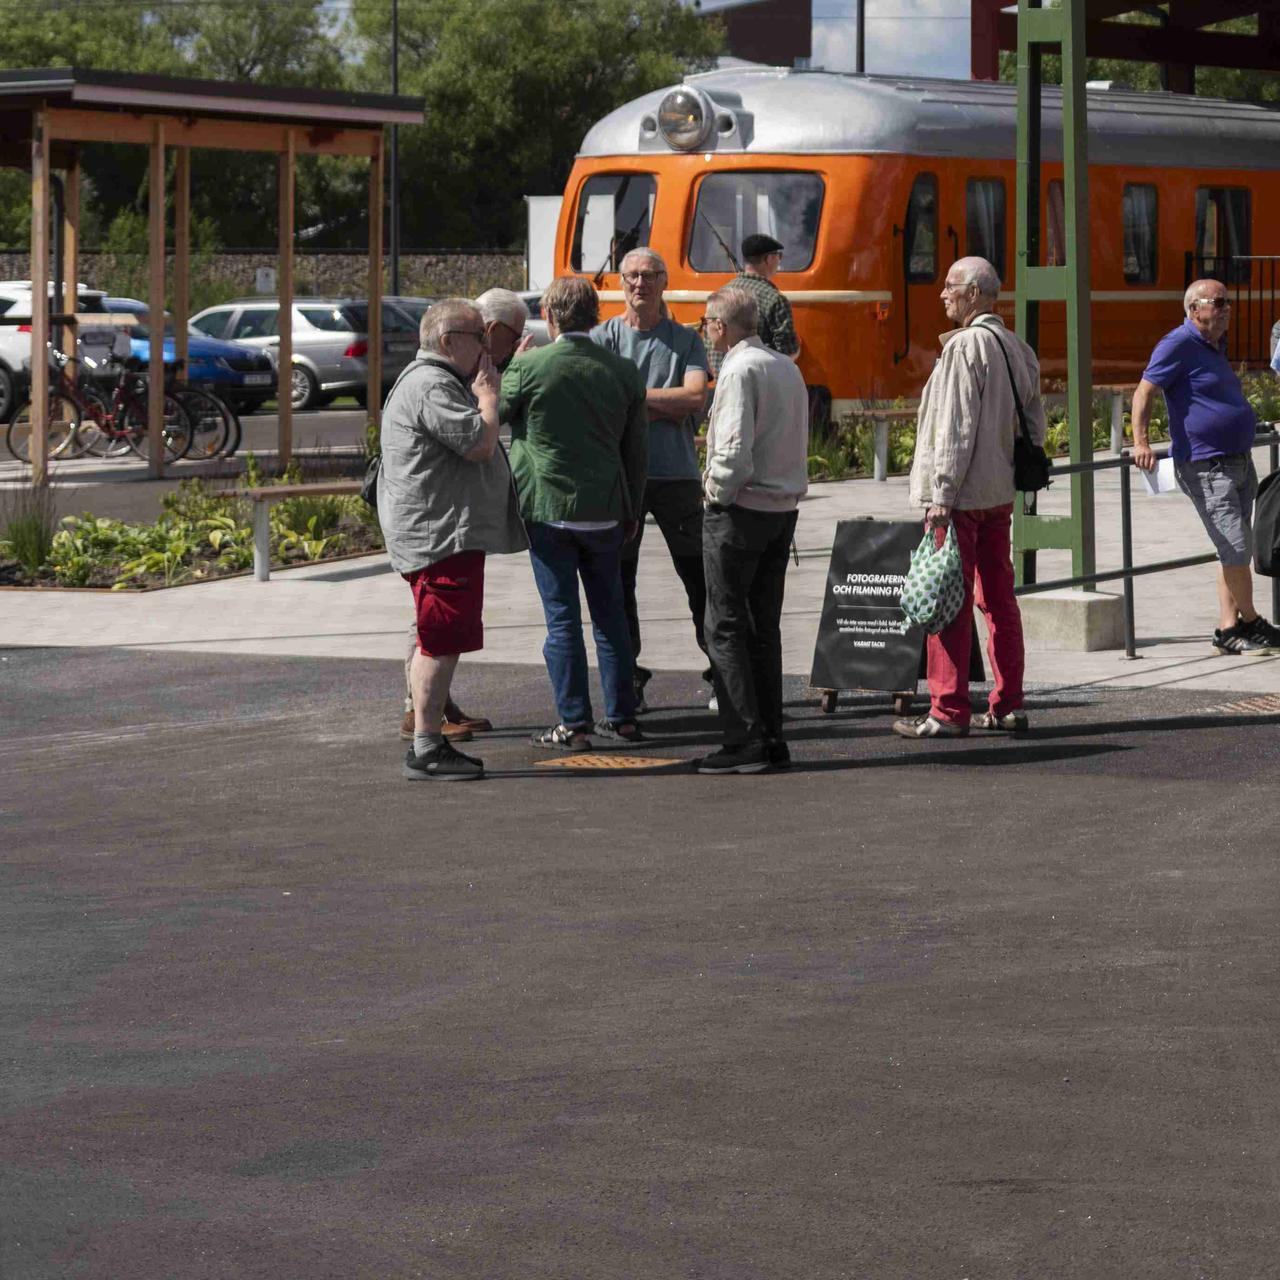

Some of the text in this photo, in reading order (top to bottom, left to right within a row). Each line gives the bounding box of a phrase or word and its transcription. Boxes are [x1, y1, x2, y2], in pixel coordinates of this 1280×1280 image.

[846, 573, 908, 585] FOTOGRAFERIN
[832, 584, 852, 594] OCH
[852, 585, 892, 596] FILMNING
